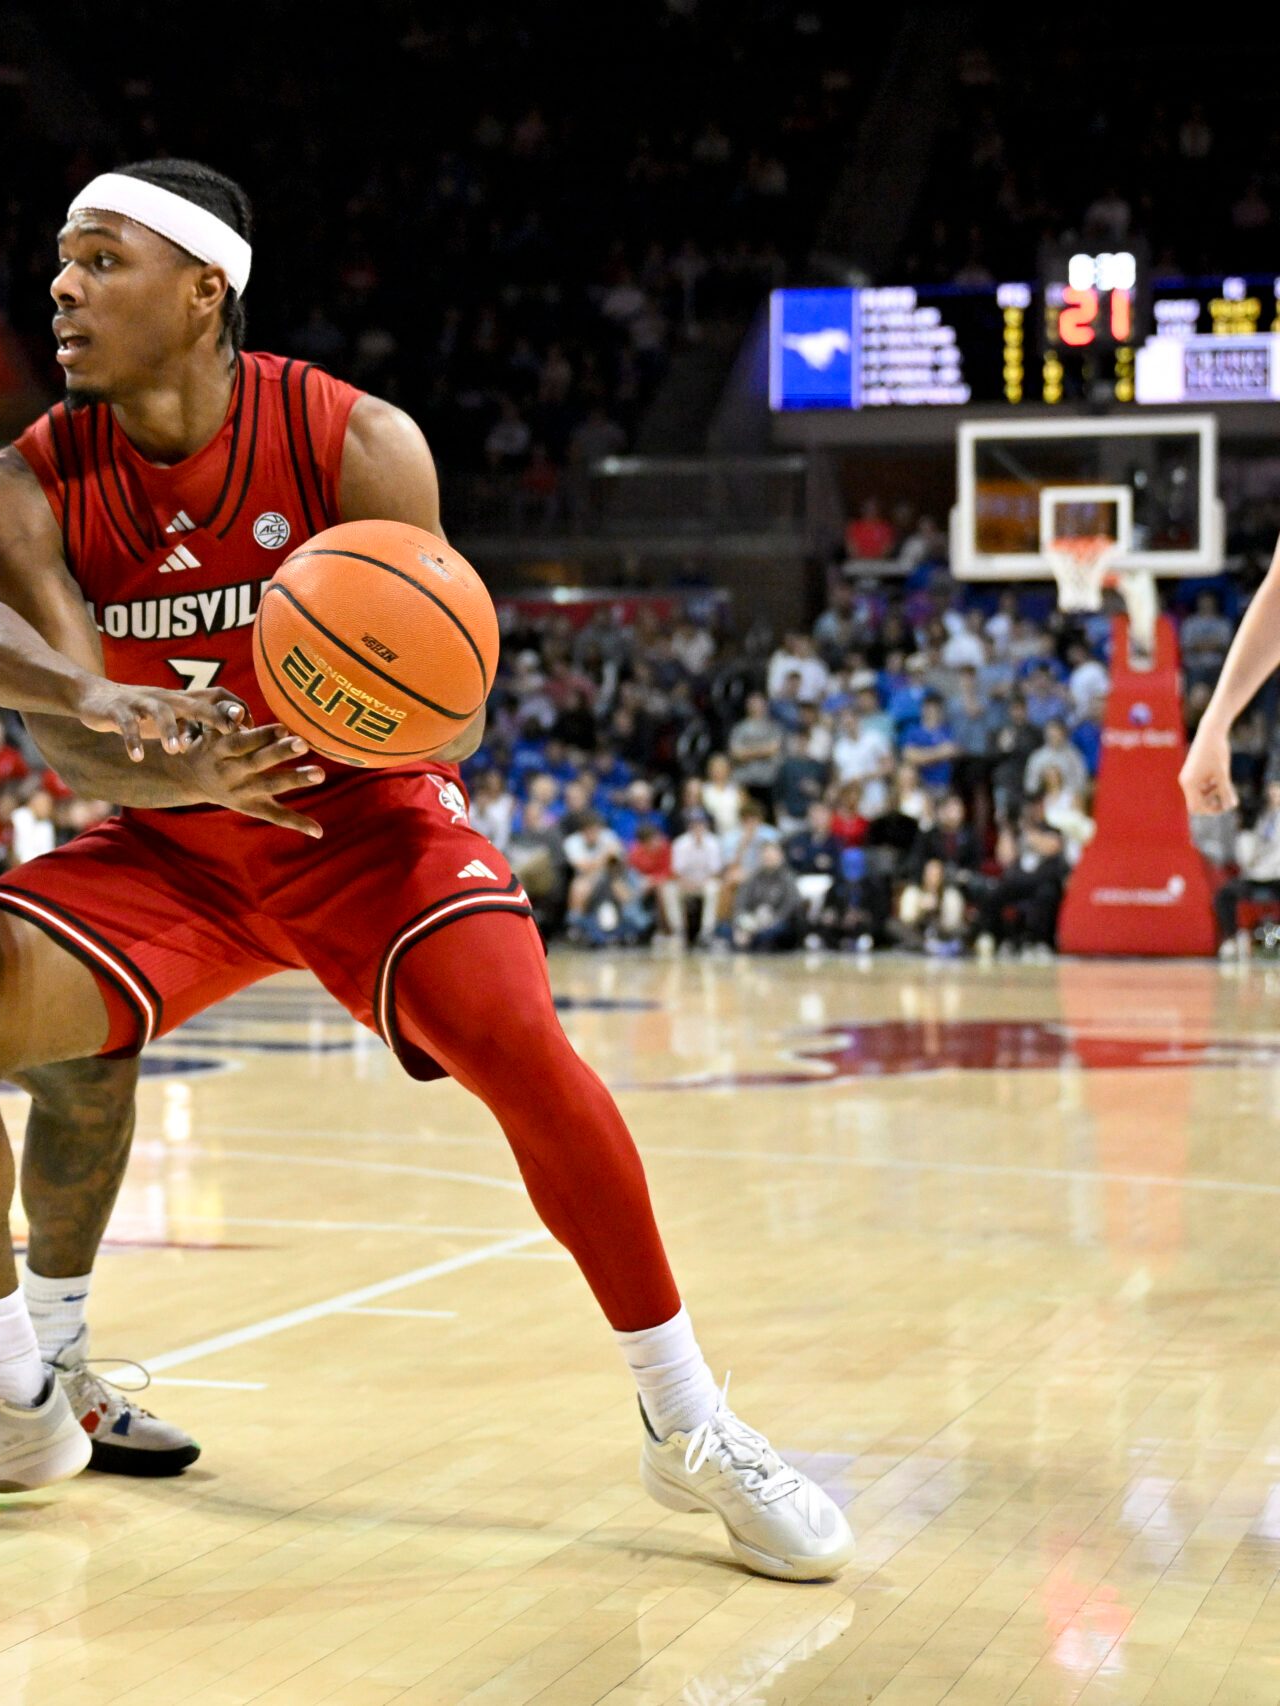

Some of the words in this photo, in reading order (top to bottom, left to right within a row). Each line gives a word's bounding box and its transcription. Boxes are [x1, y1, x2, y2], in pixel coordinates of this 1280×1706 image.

[1059, 286, 1130, 346] 21
[258, 524, 286, 535] ACC
[280, 645, 402, 744] ELITE
